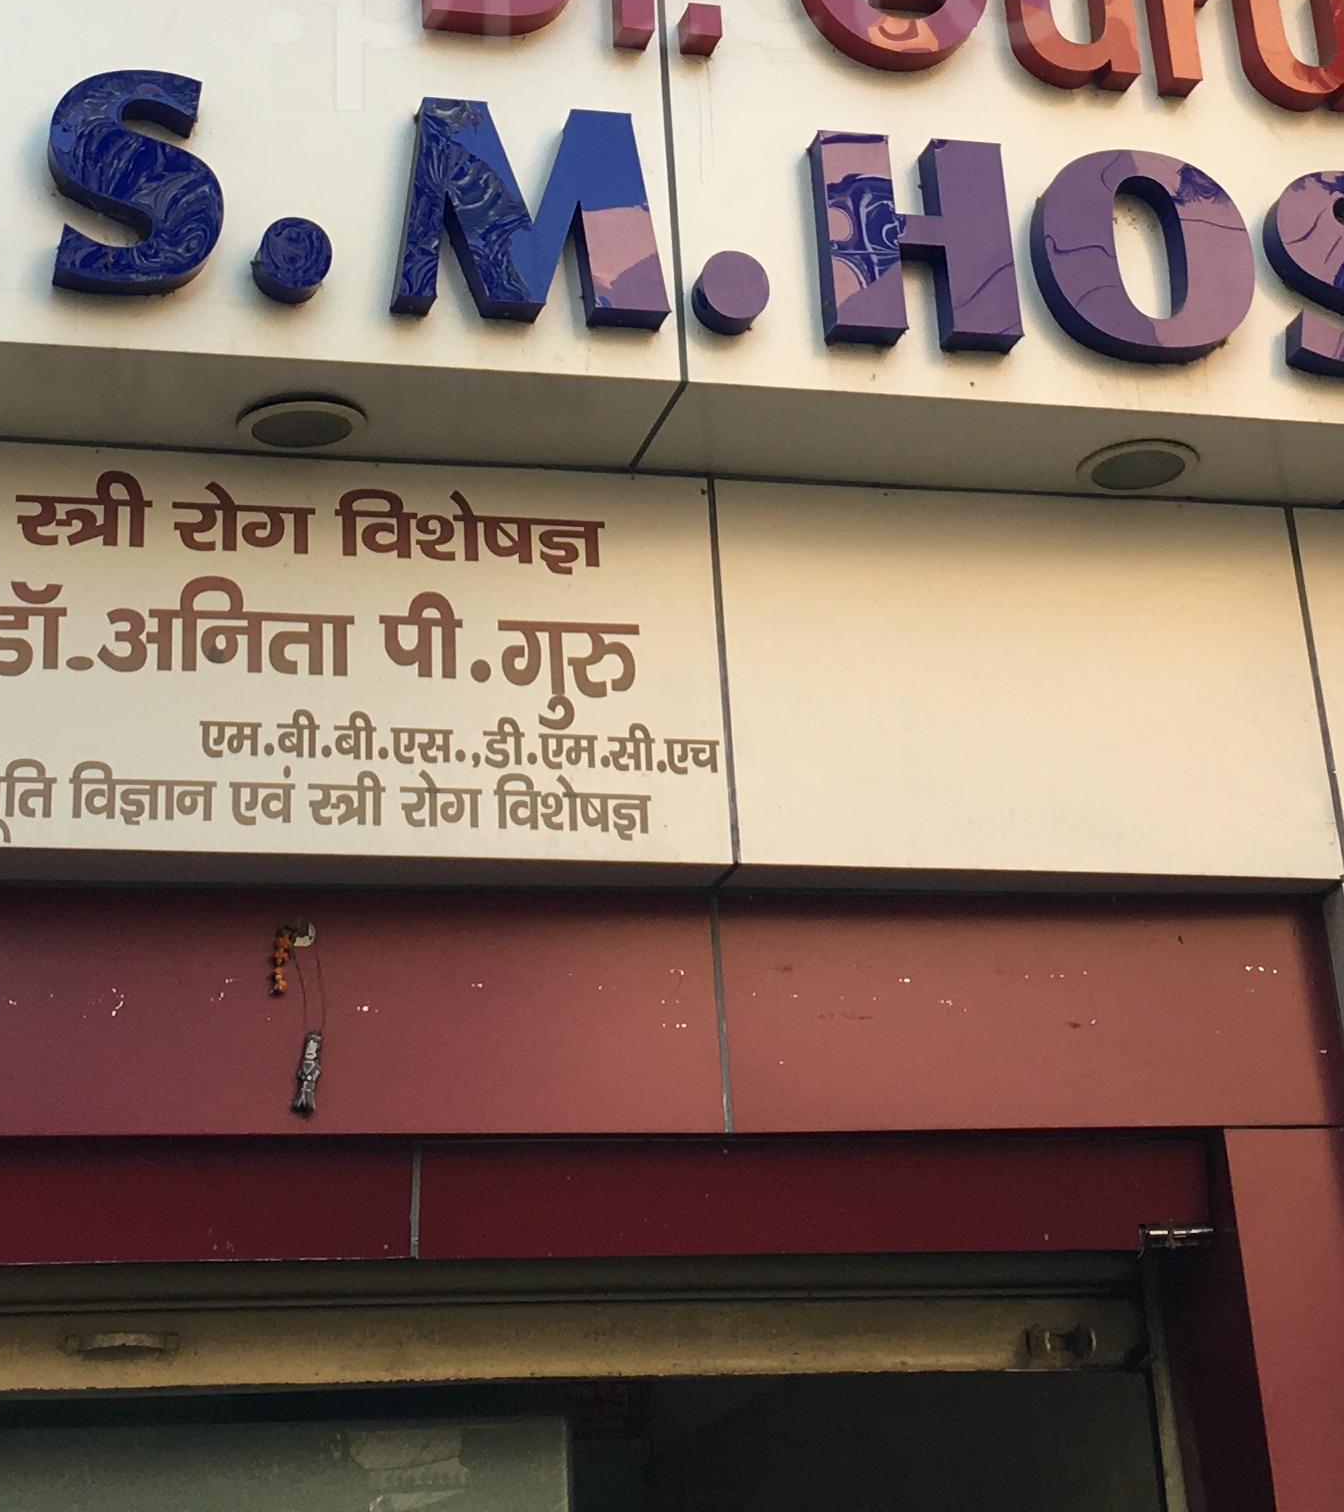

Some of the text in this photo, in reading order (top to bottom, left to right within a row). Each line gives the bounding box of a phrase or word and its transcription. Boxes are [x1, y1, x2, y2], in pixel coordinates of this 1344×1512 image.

[15, 470, 606, 575] स्त्री रोग विशेषज्ञ
[69, 760, 217, 826] विज्ञान
[229, 764, 295, 826] एवं
[308, 770, 387, 828] स्त्री
[400, 769, 483, 829] रोग
[494, 772, 652, 841] विशेषज्ञ
